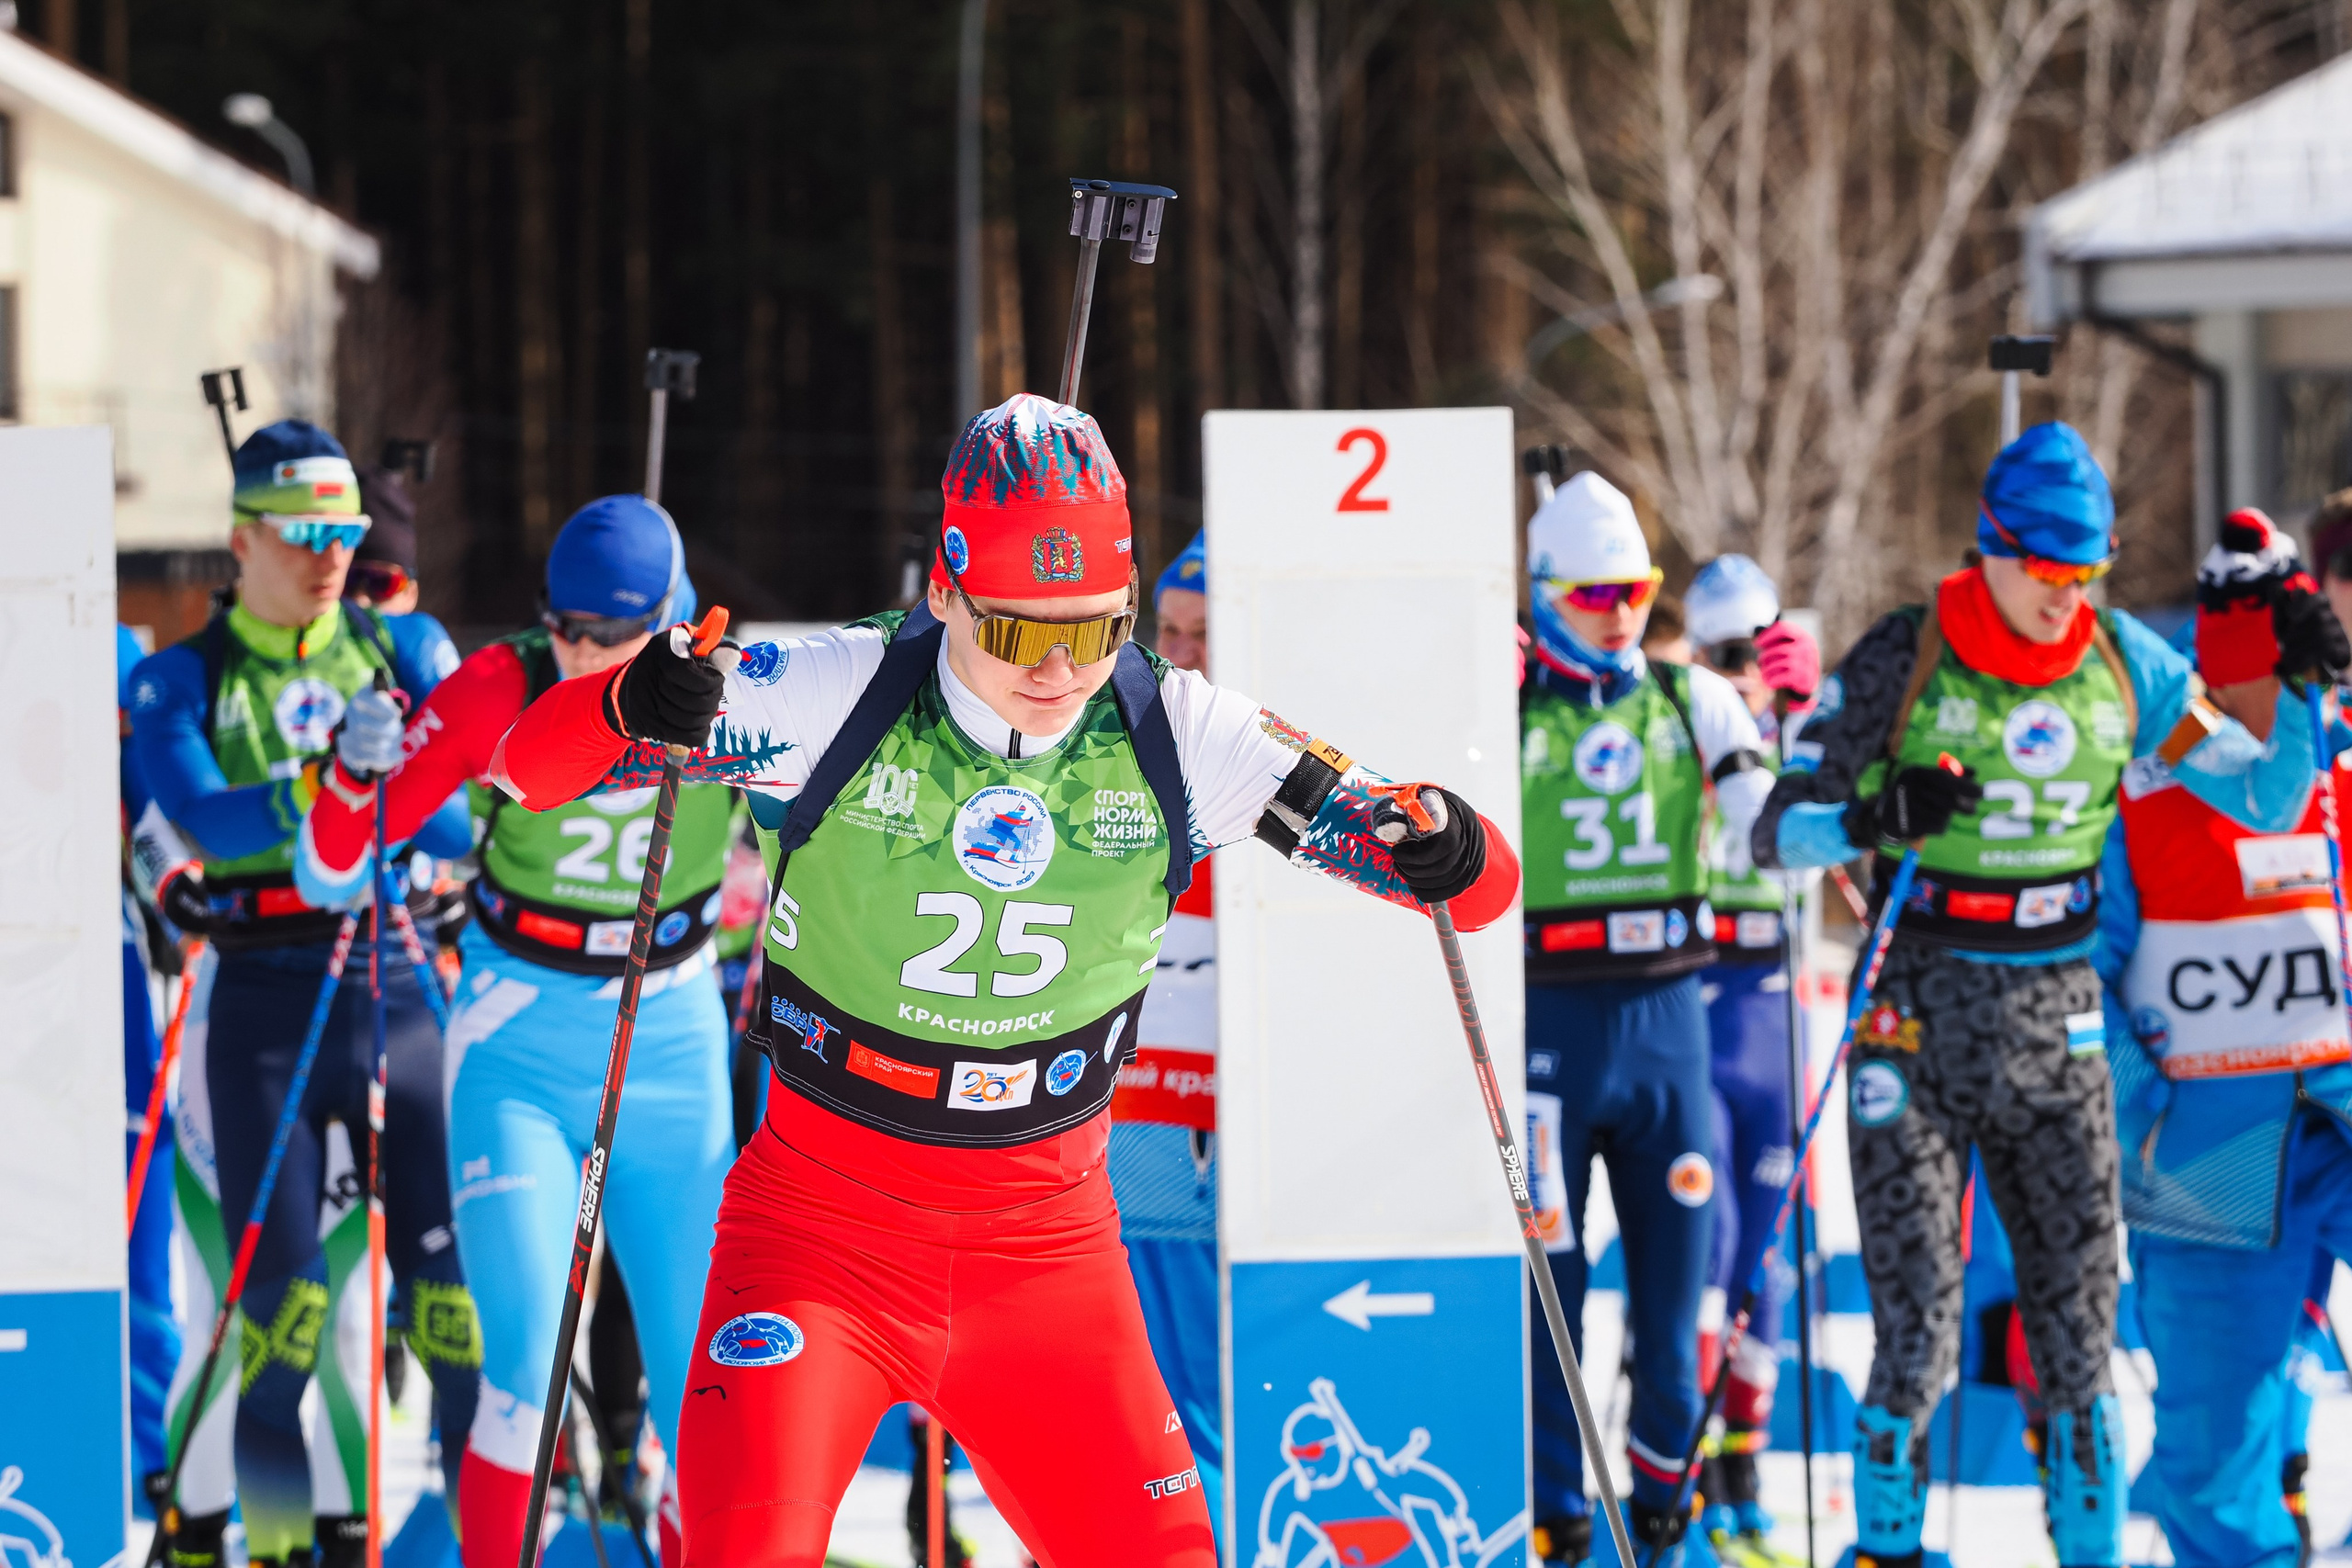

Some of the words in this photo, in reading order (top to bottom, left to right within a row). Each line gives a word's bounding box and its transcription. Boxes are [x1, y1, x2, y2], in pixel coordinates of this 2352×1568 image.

[1337, 428, 1388, 512] 2
[966, 788, 1021, 811] ПЕРВЕНСТВО
[1022, 792, 1046, 818] РОССИИ
[1094, 789, 1146, 807] СПОРТ
[1979, 779, 2092, 840] 27
[839, 815, 885, 832] РОССИЙСКОЙ
[886, 827, 926, 840] ФЕДЕРАЦИИ
[845, 809, 901, 827] МИНИСТЕРСТВО
[901, 822, 924, 831] СПОРТА
[1093, 807, 1157, 824] НОРМА
[1091, 839, 1155, 850] ФЕДЕРАЛЬНЫЙ
[1092, 823, 1158, 840] ЖИЗНИ
[1560, 791, 1671, 871] 31
[554, 816, 673, 884] 26
[1091, 850, 1125, 858] ПРОЕКТ
[968, 864, 1012, 888] Красноярск
[1015, 870, 1035, 886] 2023
[899, 891, 1075, 998] 25
[771, 1002, 808, 1031] СБР
[898, 1001, 1056, 1036] КРАСНОЯРСК
[874, 1062, 893, 1074] КРАЙ
[875, 1055, 933, 1077] КРАСНОЯРСКИЙ
[1500, 1144, 1530, 1201] SPHERE
[580, 1141, 605, 1234] SPHERE
